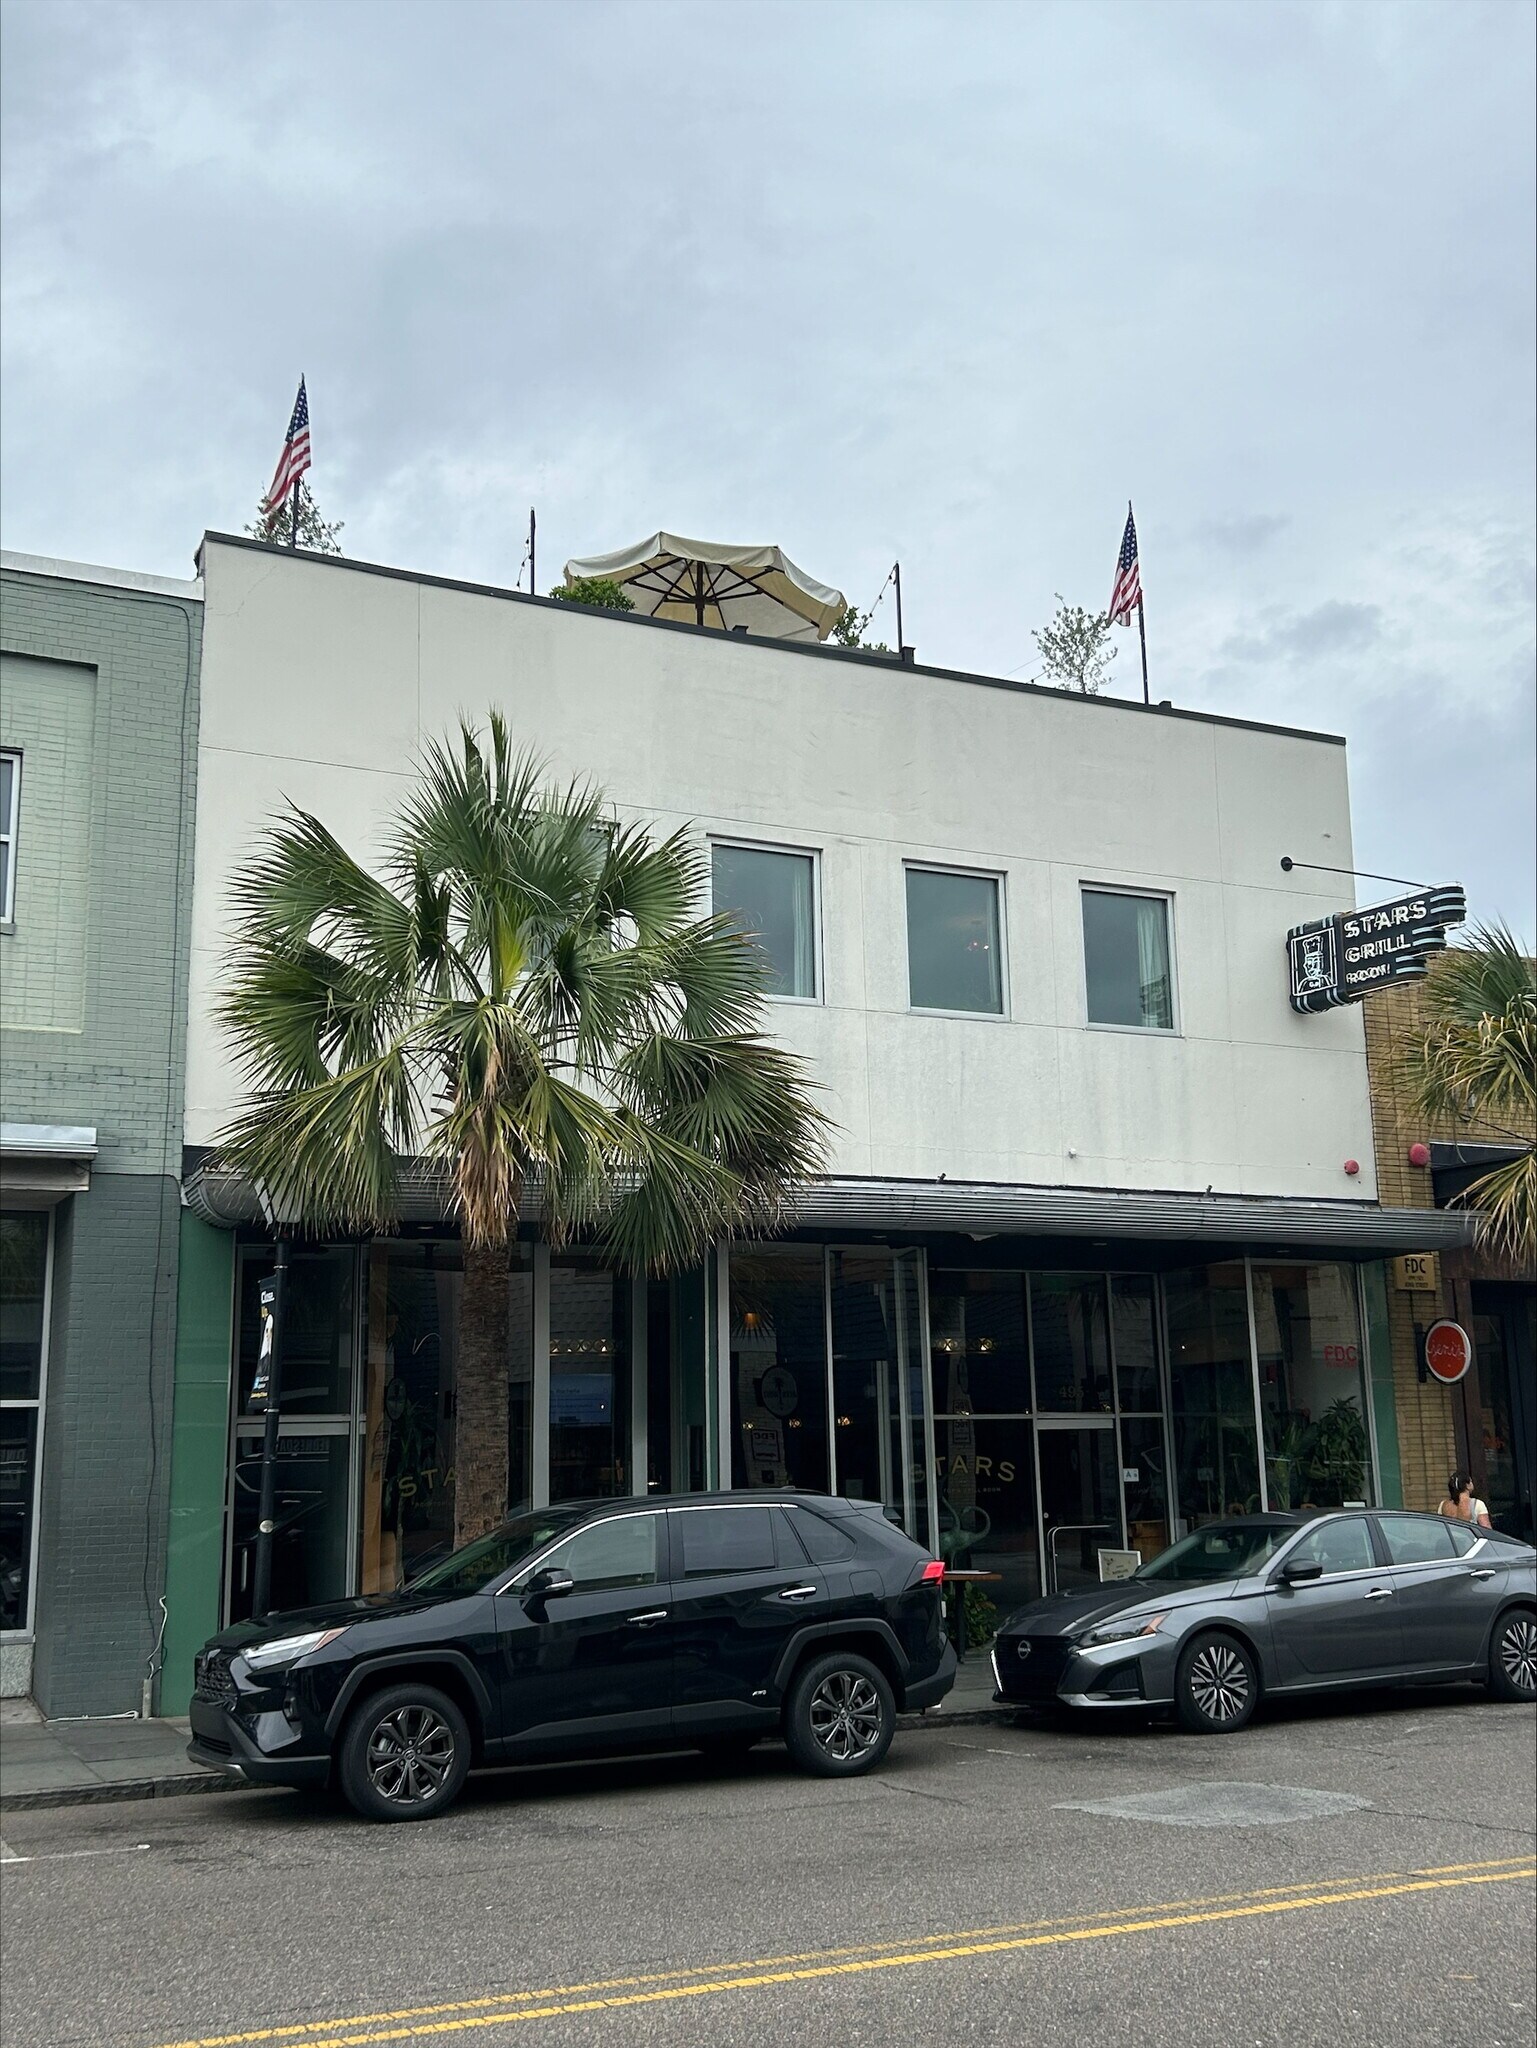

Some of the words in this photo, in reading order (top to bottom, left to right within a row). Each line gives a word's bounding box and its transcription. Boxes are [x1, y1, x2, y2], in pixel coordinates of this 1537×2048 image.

[1343, 900, 1427, 938] STARS
[1345, 934, 1411, 962] GRILL
[1346, 964, 1391, 984] ROOM
[1404, 1257, 1427, 1274] FDC
[1324, 1345, 1357, 1361] FDC
[398, 1466, 455, 1497] STA
